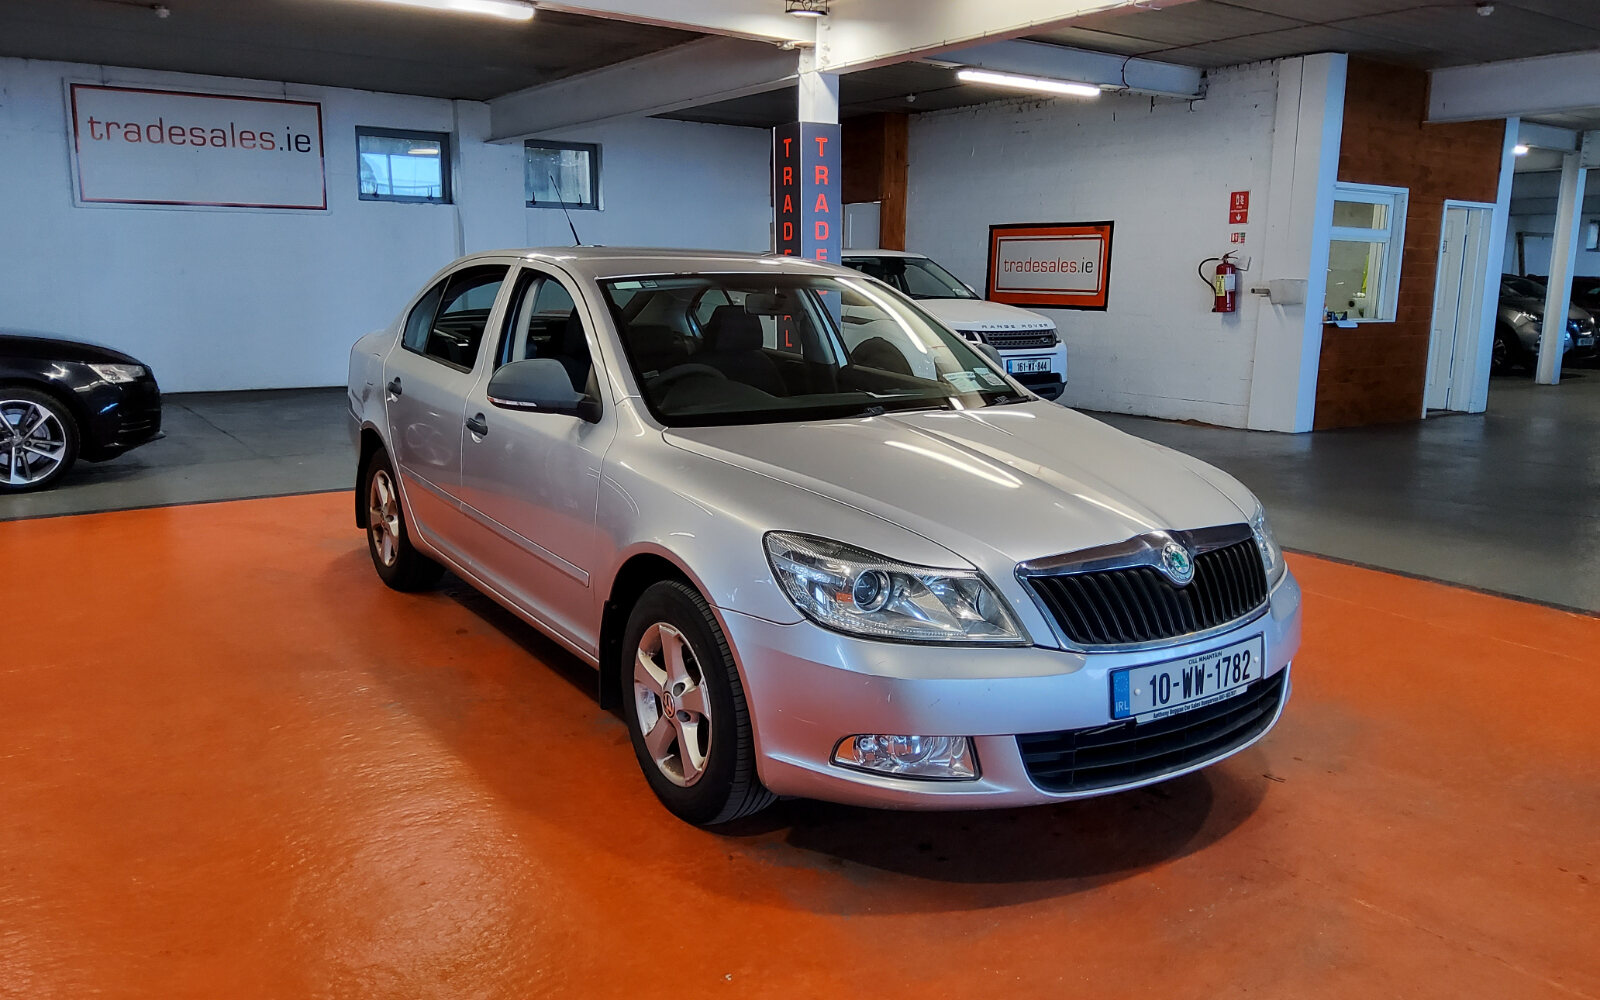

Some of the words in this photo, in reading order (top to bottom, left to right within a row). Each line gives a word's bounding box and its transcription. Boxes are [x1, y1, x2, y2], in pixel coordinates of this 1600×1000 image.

[88, 116, 311, 153] tradesales.ie
[1004, 256, 1094, 274] tradesales.ie
[1149, 649, 1251, 707] 10-WW-1782
[1115, 701, 1129, 713] IRL
